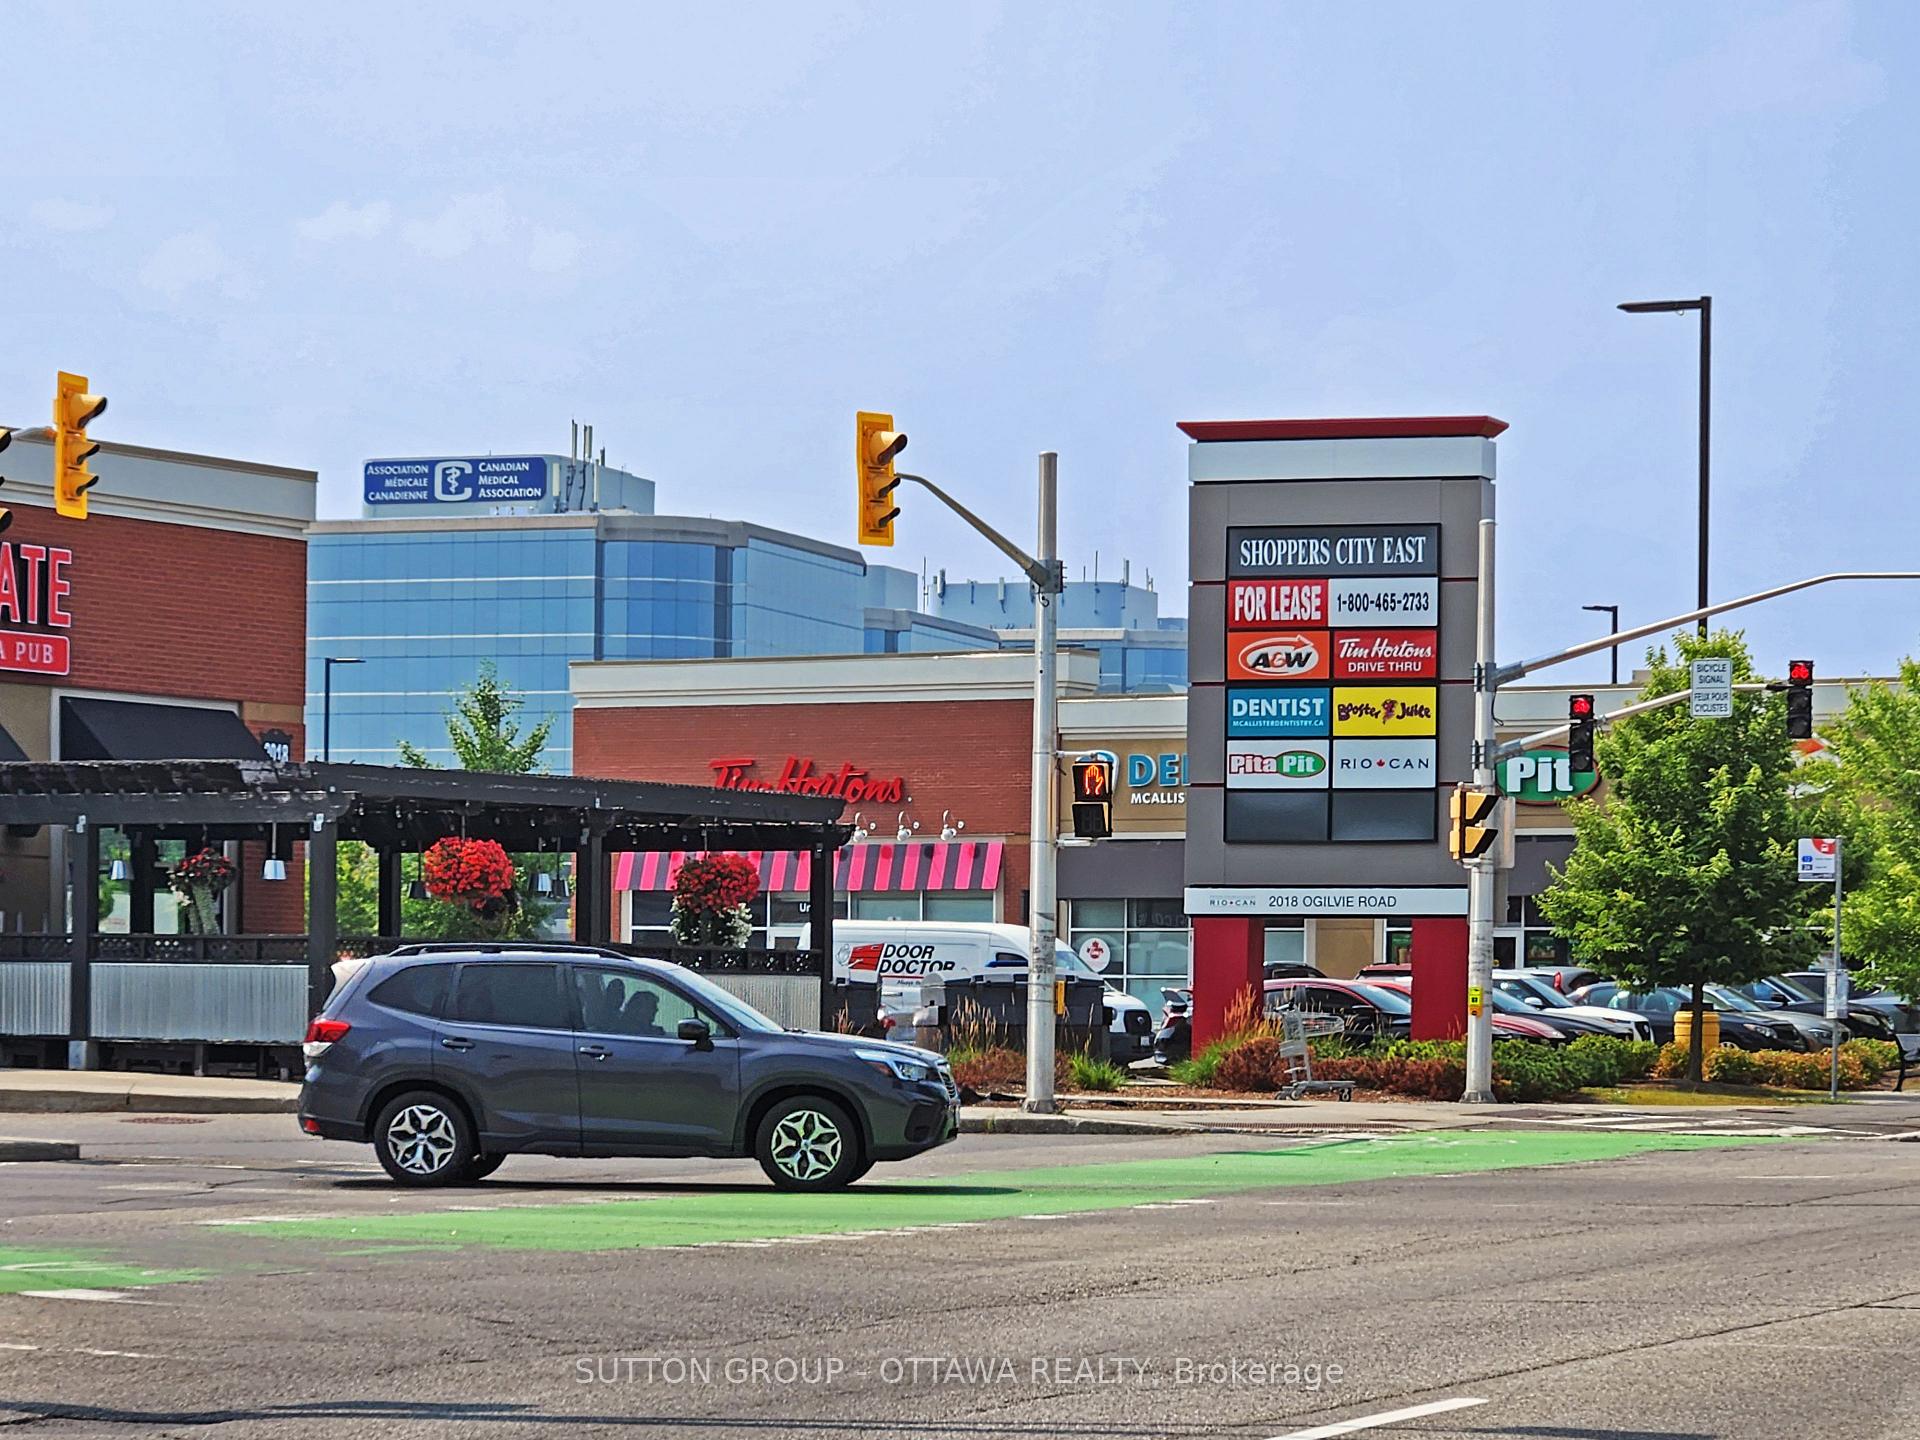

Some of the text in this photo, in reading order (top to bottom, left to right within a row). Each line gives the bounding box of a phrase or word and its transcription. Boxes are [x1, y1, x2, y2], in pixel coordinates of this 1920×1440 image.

[367, 465, 429, 475] ASSOCIATION
[479, 462, 529, 472] CANADIAN
[478, 475, 519, 485] MEDICAL
[368, 490, 428, 501] CANADIENNE
[478, 488, 542, 498] ASSOCIATION
[1240, 536, 1426, 566] SHOPPERS CITY EAST
[1234, 585, 1322, 622] FOR LEASE
[1337, 592, 1430, 612] 1-800-465-2733
[15, 641, 54, 665] PUB
[1339, 637, 1432, 659] Tim Hortons
[1251, 651, 1313, 669] A&W
[1347, 661, 1422, 673] DRIVE THRU
[1696, 664, 1727, 672] BICYCLE
[1698, 675, 1725, 683] SIGNAL
[1232, 697, 1325, 717] DENTIST
[1337, 702, 1431, 721] Booster Juice
[1232, 719, 1324, 727] MCALLISTERDENTISTRY.CA
[1229, 754, 1316, 774] Pita Pit
[775, 754, 903, 804] Hortons
[1506, 756, 1574, 793] Pit
[1130, 792, 1186, 805] MCALLIS
[1268, 895, 1398, 908] 2018 OGILVIE ROAD
[883, 944, 936, 960] DOOR
